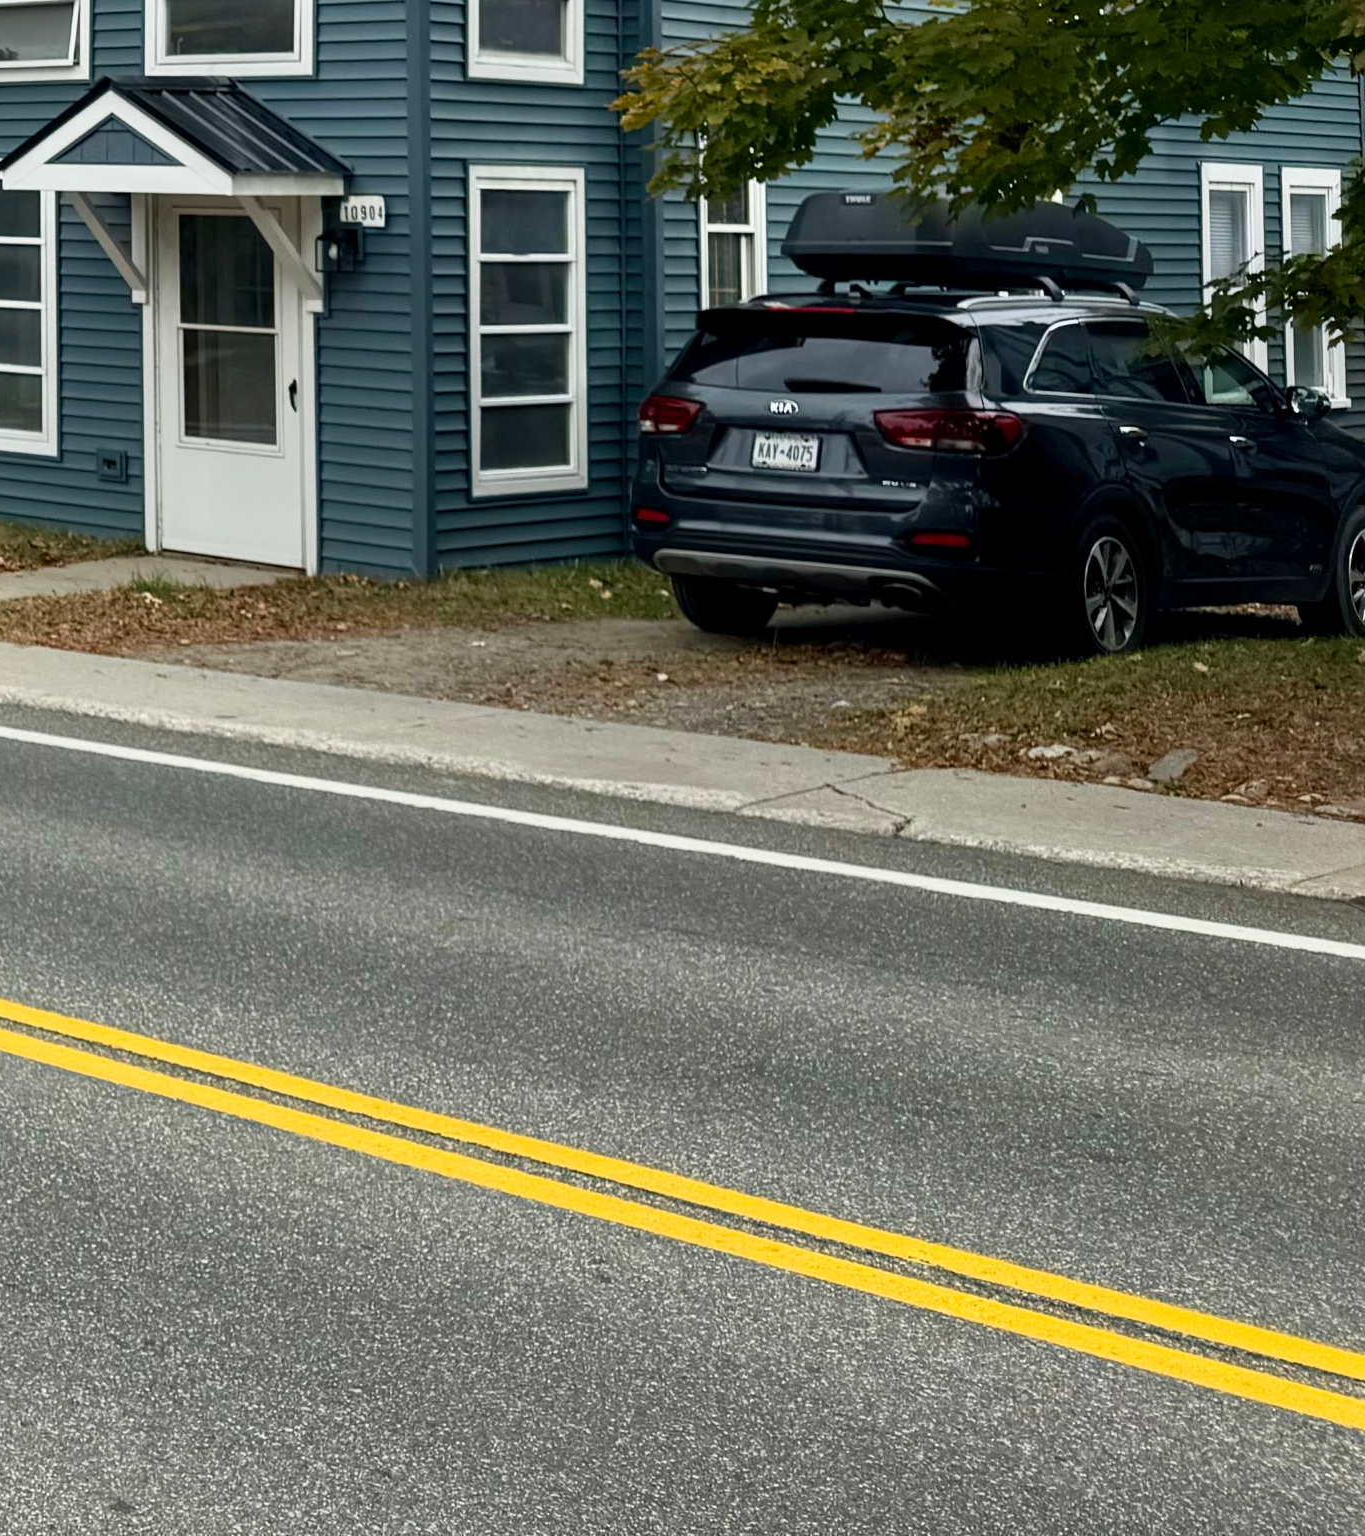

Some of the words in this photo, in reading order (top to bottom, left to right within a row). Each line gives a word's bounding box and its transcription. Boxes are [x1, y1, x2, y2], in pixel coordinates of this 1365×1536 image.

[344, 205, 383, 221] 10904
[770, 401, 793, 414] KIA
[786, 444, 814, 463] 4075
